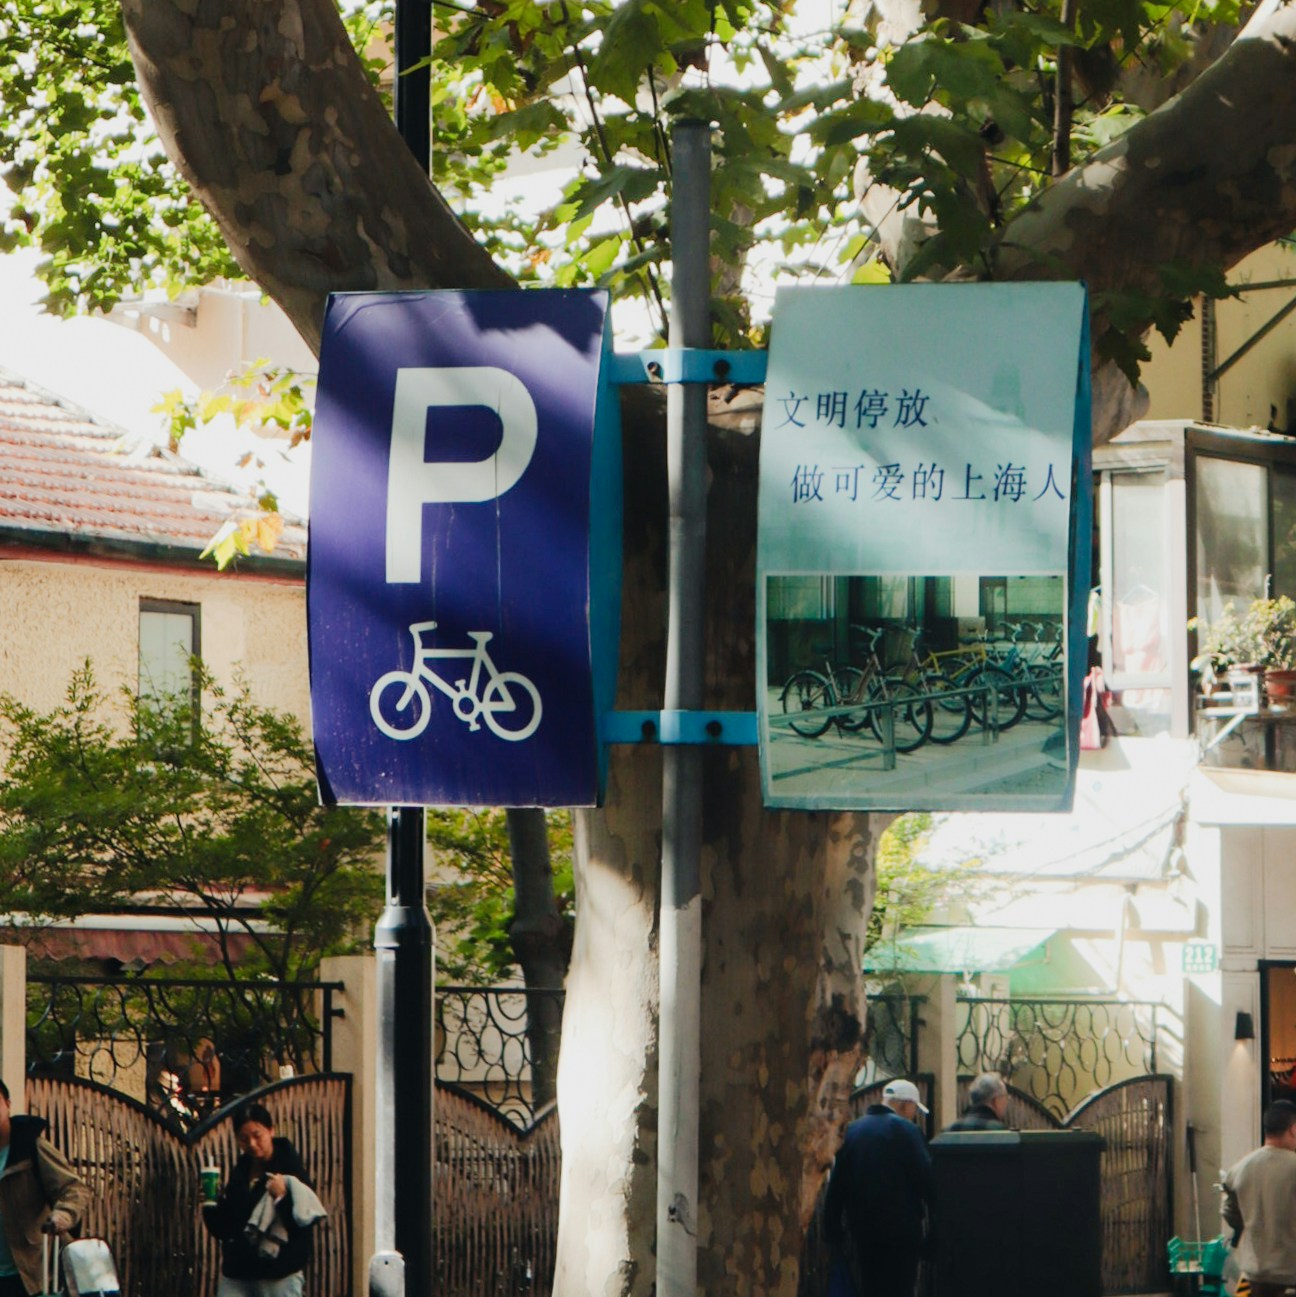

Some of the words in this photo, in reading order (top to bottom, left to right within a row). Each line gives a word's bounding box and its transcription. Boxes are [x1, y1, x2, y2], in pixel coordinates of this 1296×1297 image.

[772, 388, 930, 429] 文明停放
[385, 366, 538, 584] P
[790, 462, 1067, 505] 做可爱的上海人
[1185, 946, 1213, 963] 212
